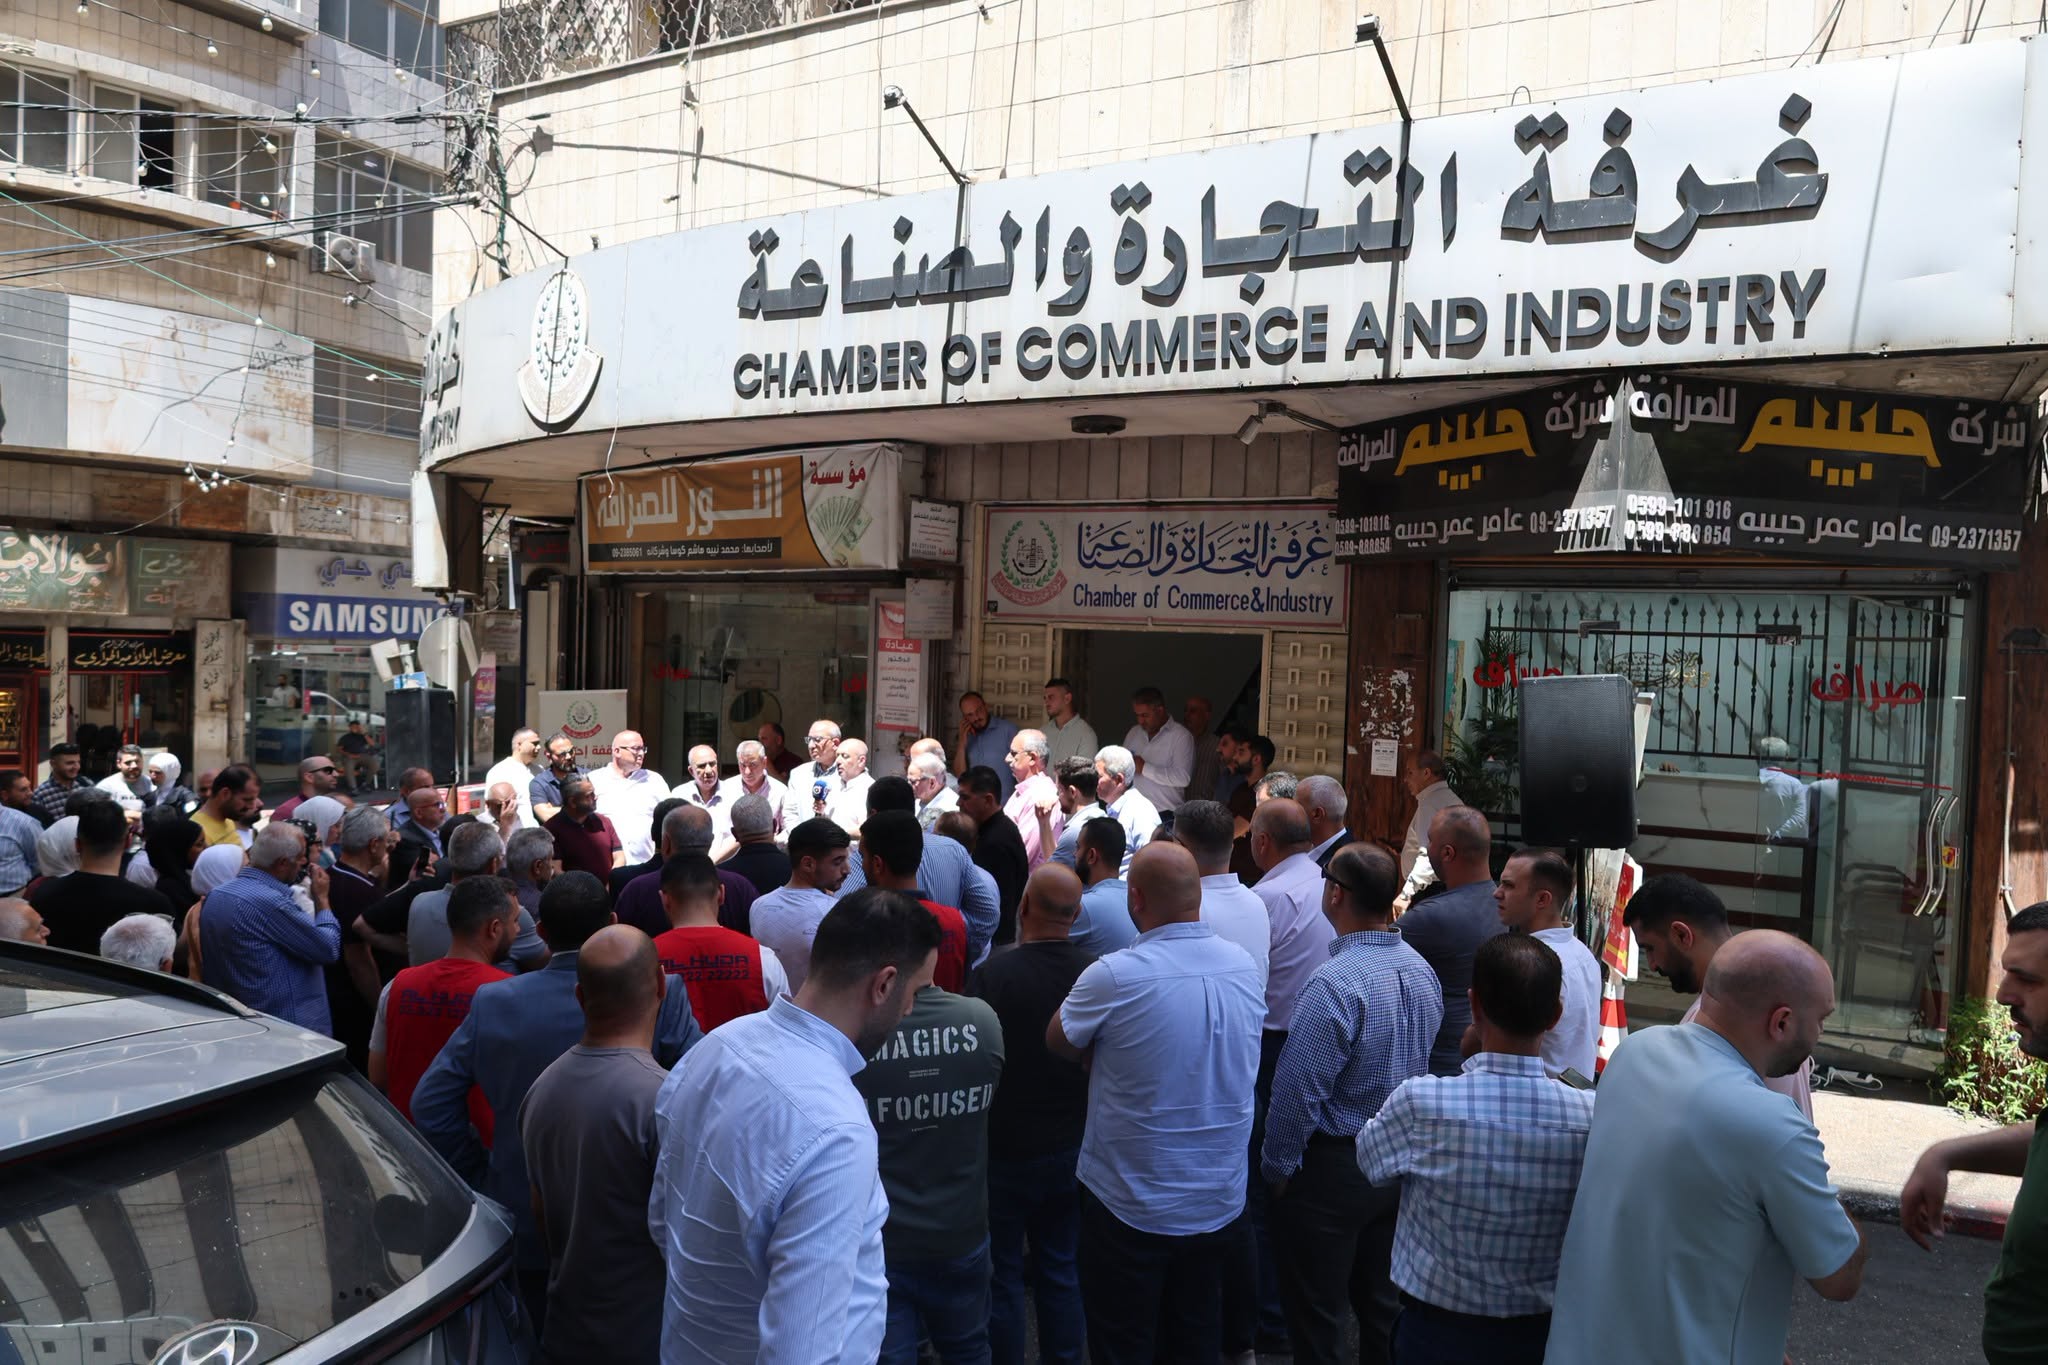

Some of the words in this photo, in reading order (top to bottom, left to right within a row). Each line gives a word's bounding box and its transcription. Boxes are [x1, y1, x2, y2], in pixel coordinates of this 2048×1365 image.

[1500, 92, 1829, 263] غرفة
[1110, 145, 1458, 308] التجارة
[737, 204, 1093, 318] والصناعة
[733, 340, 927, 399] CHAMBER
[942, 330, 1001, 386] OF
[1016, 304, 1329, 382] COMMERCE
[1344, 296, 1488, 361] AND
[1504, 268, 1827, 357] INDUSTRY
[1337, 428, 1396, 473] للصرافة
[1545, 379, 1615, 440] شركة
[1628, 374, 1737, 433] للصرافة
[1948, 402, 2027, 456] شركة
[808, 460, 867, 490] مؤسسة
[597, 474, 679, 539] للصرافة
[686, 467, 783, 537] النور
[1705, 500, 1732, 520] 916
[1438, 516, 1475, 545] عمر
[1477, 507, 1524, 541] عامر
[1529, 504, 1617, 535] 09-2371357
[1703, 524, 1732, 545] 854
[1806, 516, 1861, 544] عمر
[1862, 515, 1923, 548] عامر
[687, 544, 705, 558] هاشم
[705, 544, 720, 557] نبيه
[721, 545, 740, 555] محمد
[1929, 524, 2022, 552] 09-2371357
[1073, 583, 1137, 608] Chamber
[1143, 584, 1161, 608] of
[885, 641, 914, 651] عيادة
[1811, 662, 1925, 713] صراف
[591, 744, 613, 756] قفة
